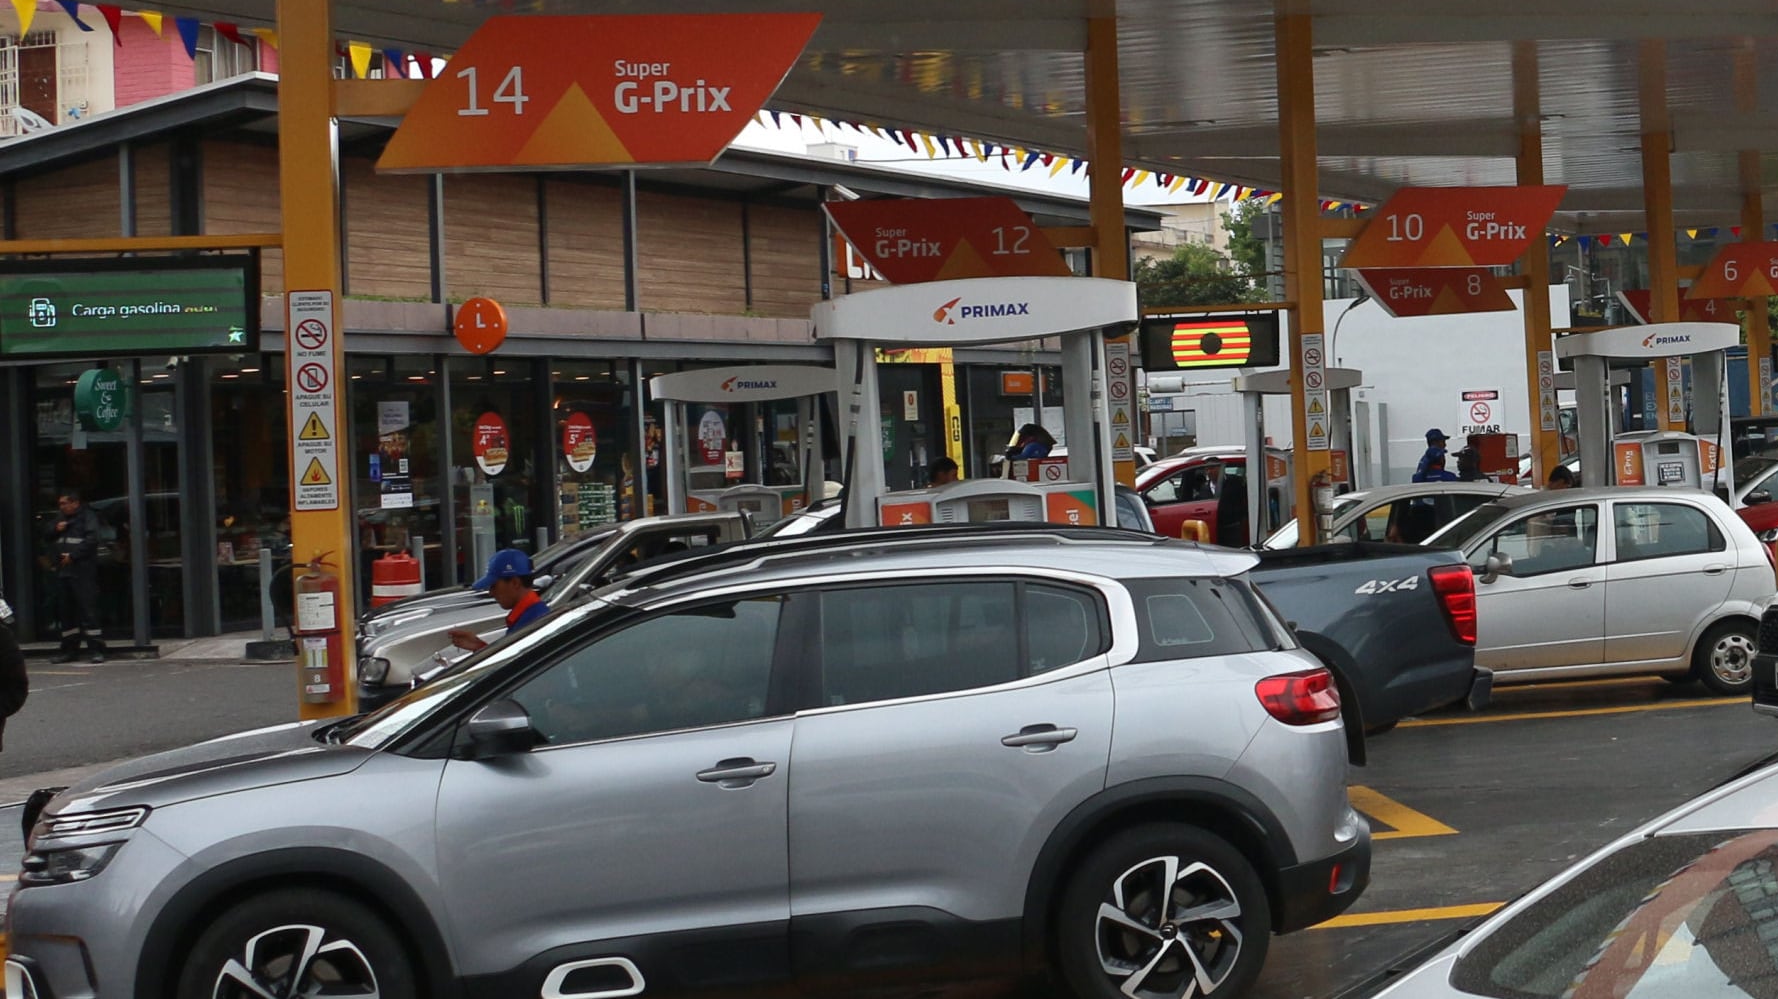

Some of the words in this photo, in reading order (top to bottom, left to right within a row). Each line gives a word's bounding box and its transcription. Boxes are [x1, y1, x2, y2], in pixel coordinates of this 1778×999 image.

[614, 60, 670, 79] Super
[456, 66, 529, 116] 14
[614, 80, 732, 113] G-Prix
[1466, 211, 1496, 222] Super
[875, 228, 907, 239] Super
[1386, 213, 1424, 241] 10
[1466, 222, 1526, 240] G-Prix
[875, 239, 942, 258] G-Prix
[992, 226, 1030, 255] 12
[1724, 260, 1738, 281] 6
[1389, 286, 1432, 299] G-Prix
[1467, 274, 1481, 296] 8
[72, 303, 116, 319] Carga
[119, 302, 181, 318] gasolina
[961, 303, 1029, 318] PRIMAX
[1656, 335, 1691, 345] PRIMAX
[737, 380, 777, 389] PRIMAX
[1462, 424, 1500, 434] FUMAR
